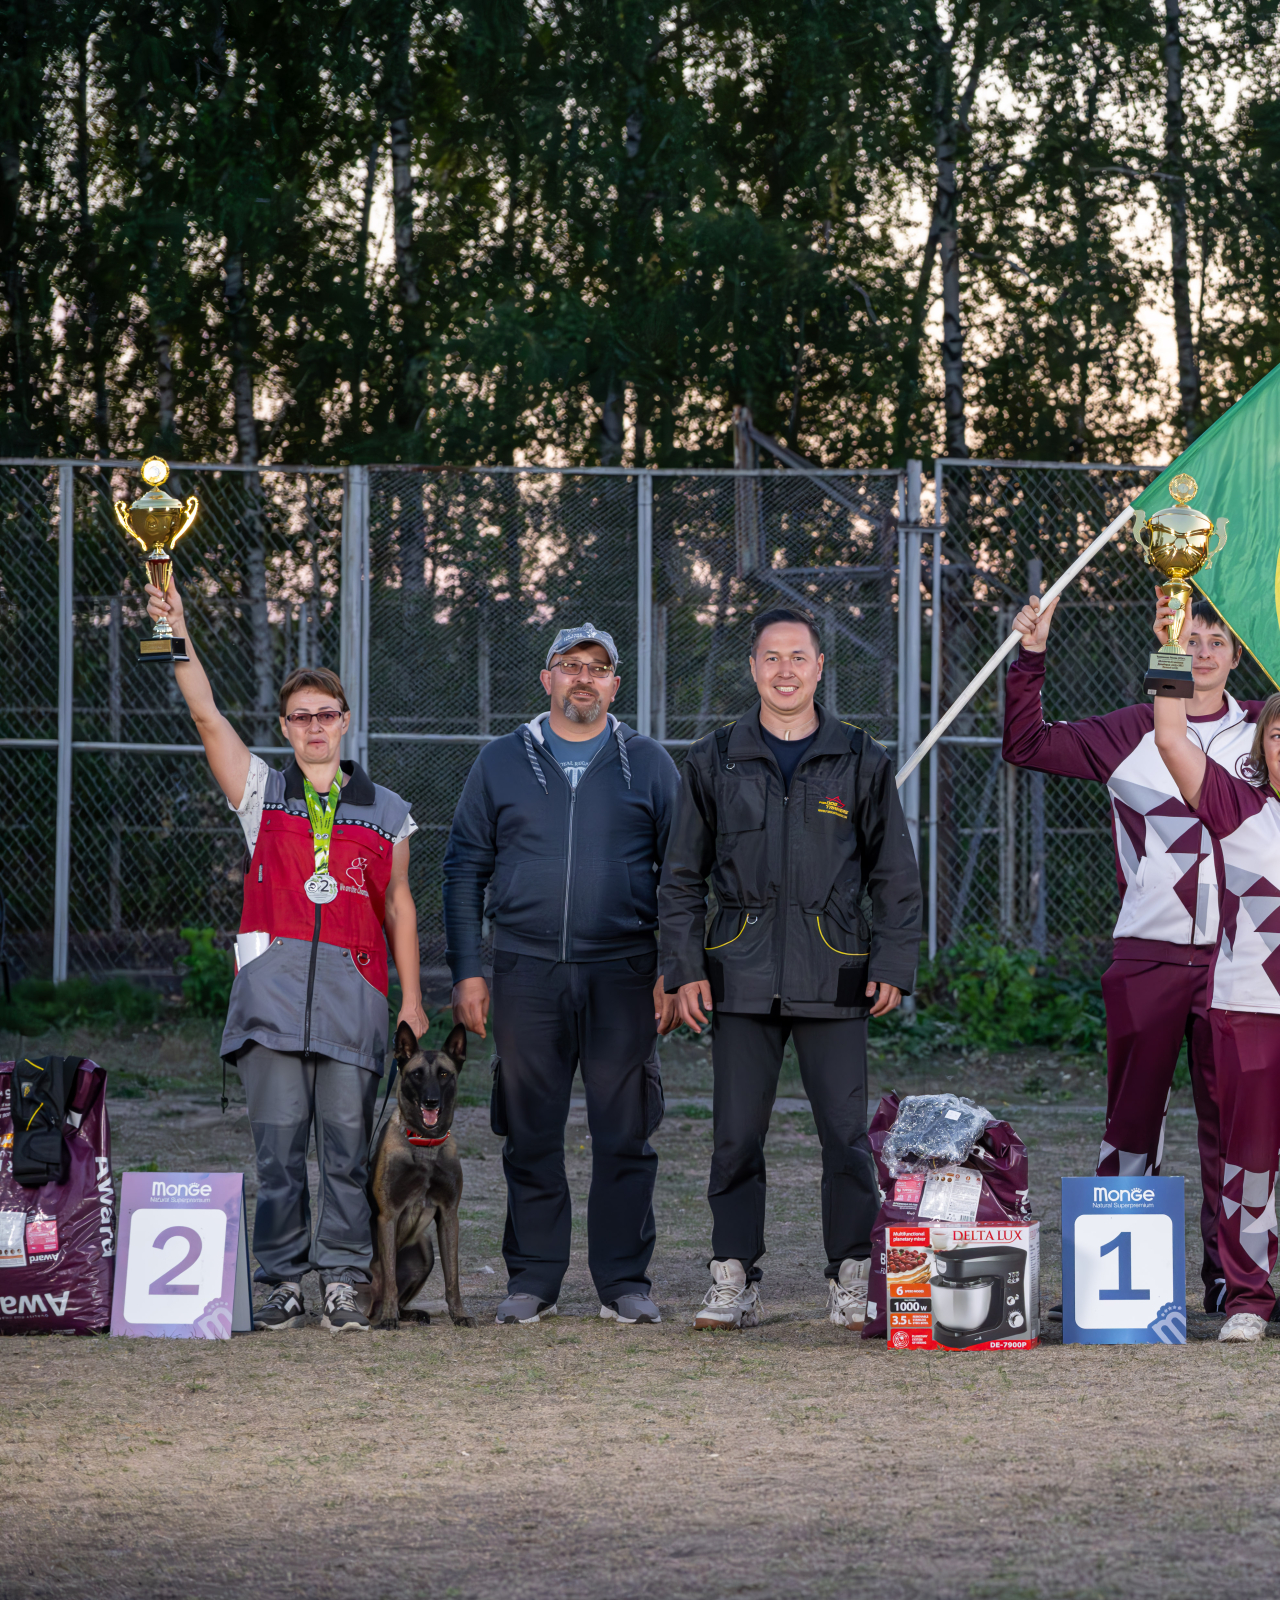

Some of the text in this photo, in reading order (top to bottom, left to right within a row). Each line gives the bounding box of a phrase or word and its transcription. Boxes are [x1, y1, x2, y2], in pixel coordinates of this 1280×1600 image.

[320, 880, 330, 892] 2
[170, 1196, 211, 1204] Superpremium
[95, 1156, 115, 1258] Award
[953, 1230, 1023, 1241] DELTA LUX
[29, 1252, 60, 1264] Award
[148, 1225, 203, 1296] 2
[1099, 1231, 1151, 1301] 1
[896, 1286, 904, 1296] 6
[894, 1301, 920, 1311] 1000
[892, 1315, 907, 1325] 3.5
